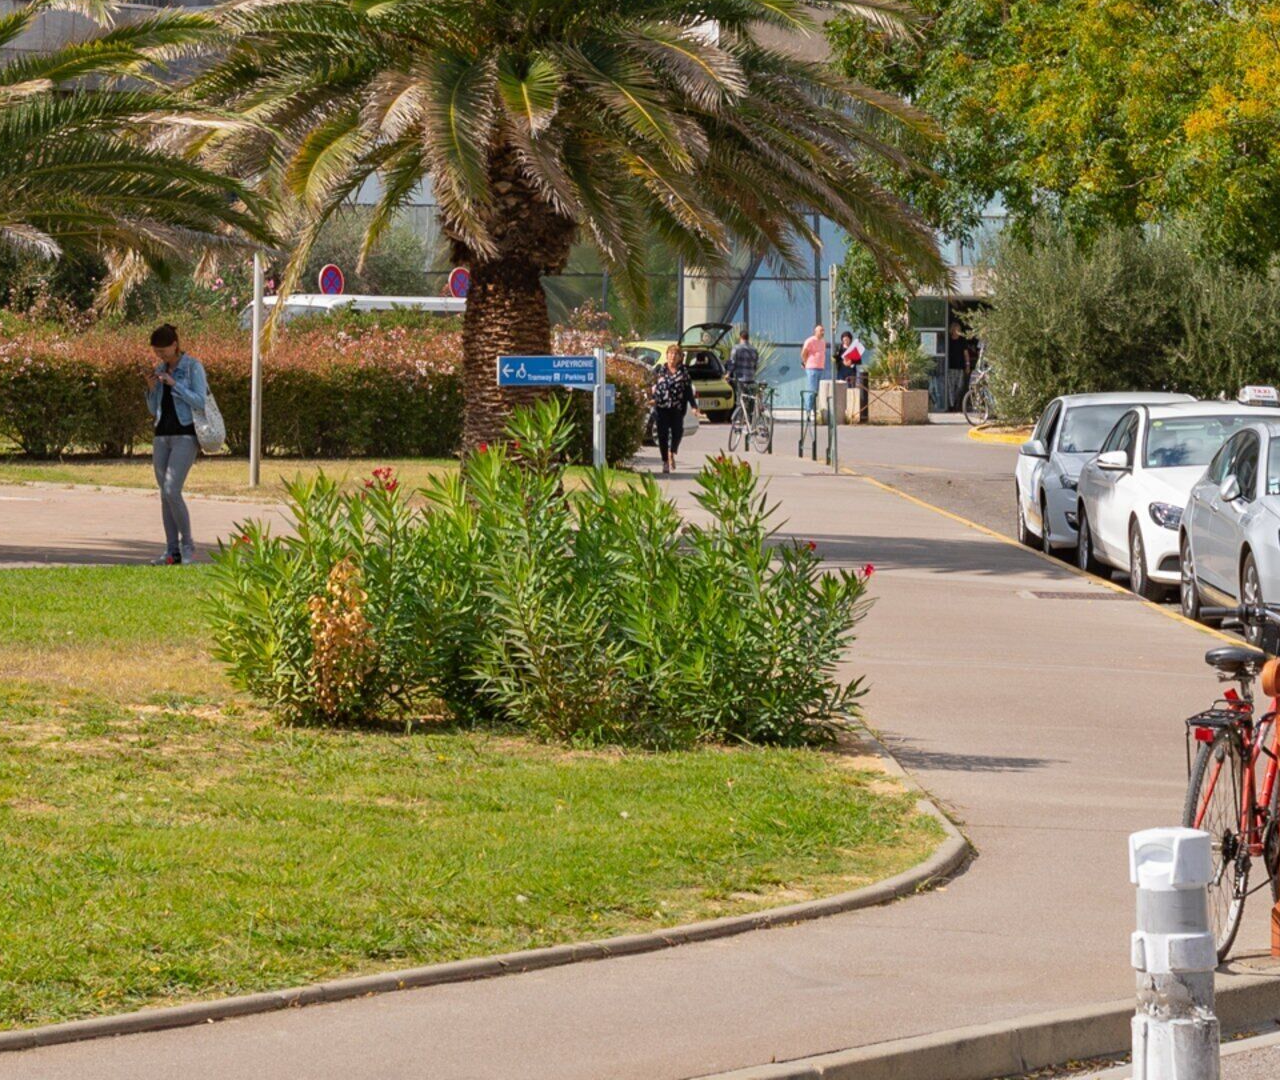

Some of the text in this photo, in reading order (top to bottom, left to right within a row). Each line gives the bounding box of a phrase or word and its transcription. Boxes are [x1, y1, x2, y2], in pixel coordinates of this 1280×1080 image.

[553, 360, 594, 368] LAPEYRONIE
[527, 373, 552, 382] Tramway
[565, 373, 586, 382] Parking
